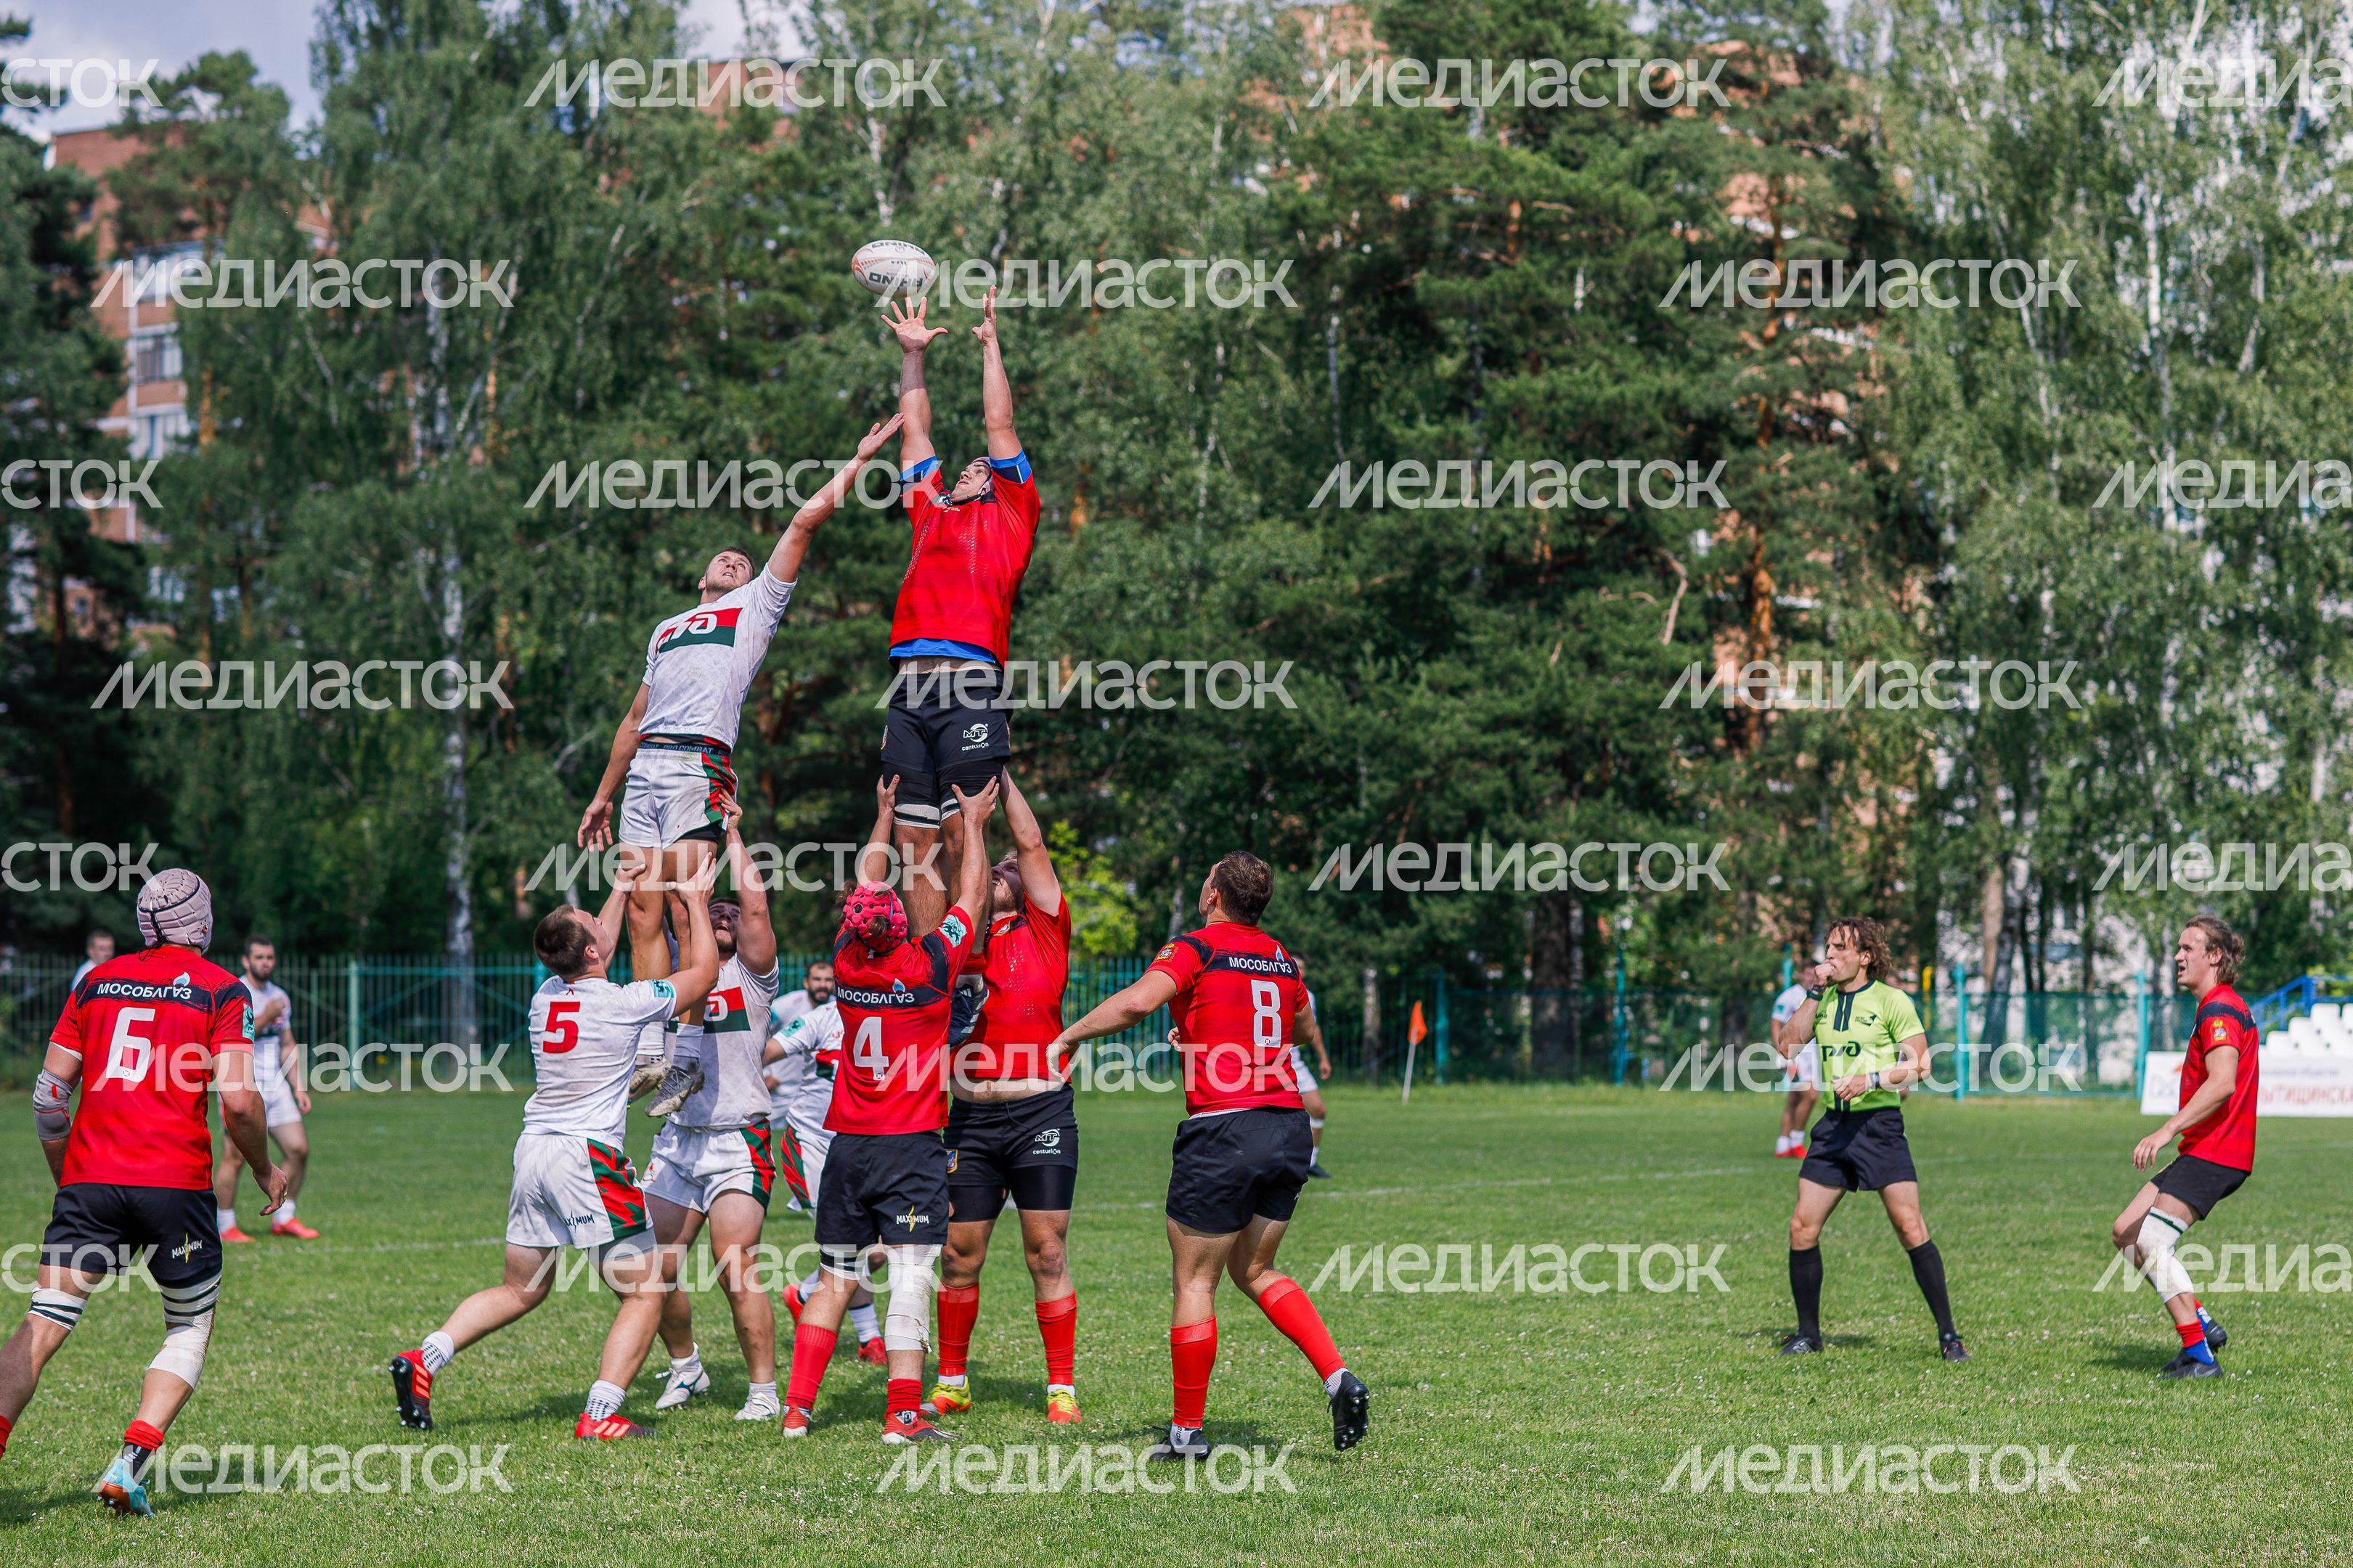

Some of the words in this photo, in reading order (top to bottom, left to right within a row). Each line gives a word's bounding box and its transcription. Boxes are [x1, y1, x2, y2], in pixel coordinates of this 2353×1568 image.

[868, 271, 924, 287] RHINO
[679, 745, 714, 754] COMBAT
[542, 1001, 581, 1054] 5
[1250, 979, 1282, 1048] 8
[106, 1007, 156, 1083] 6
[853, 1016, 889, 1081] 4
